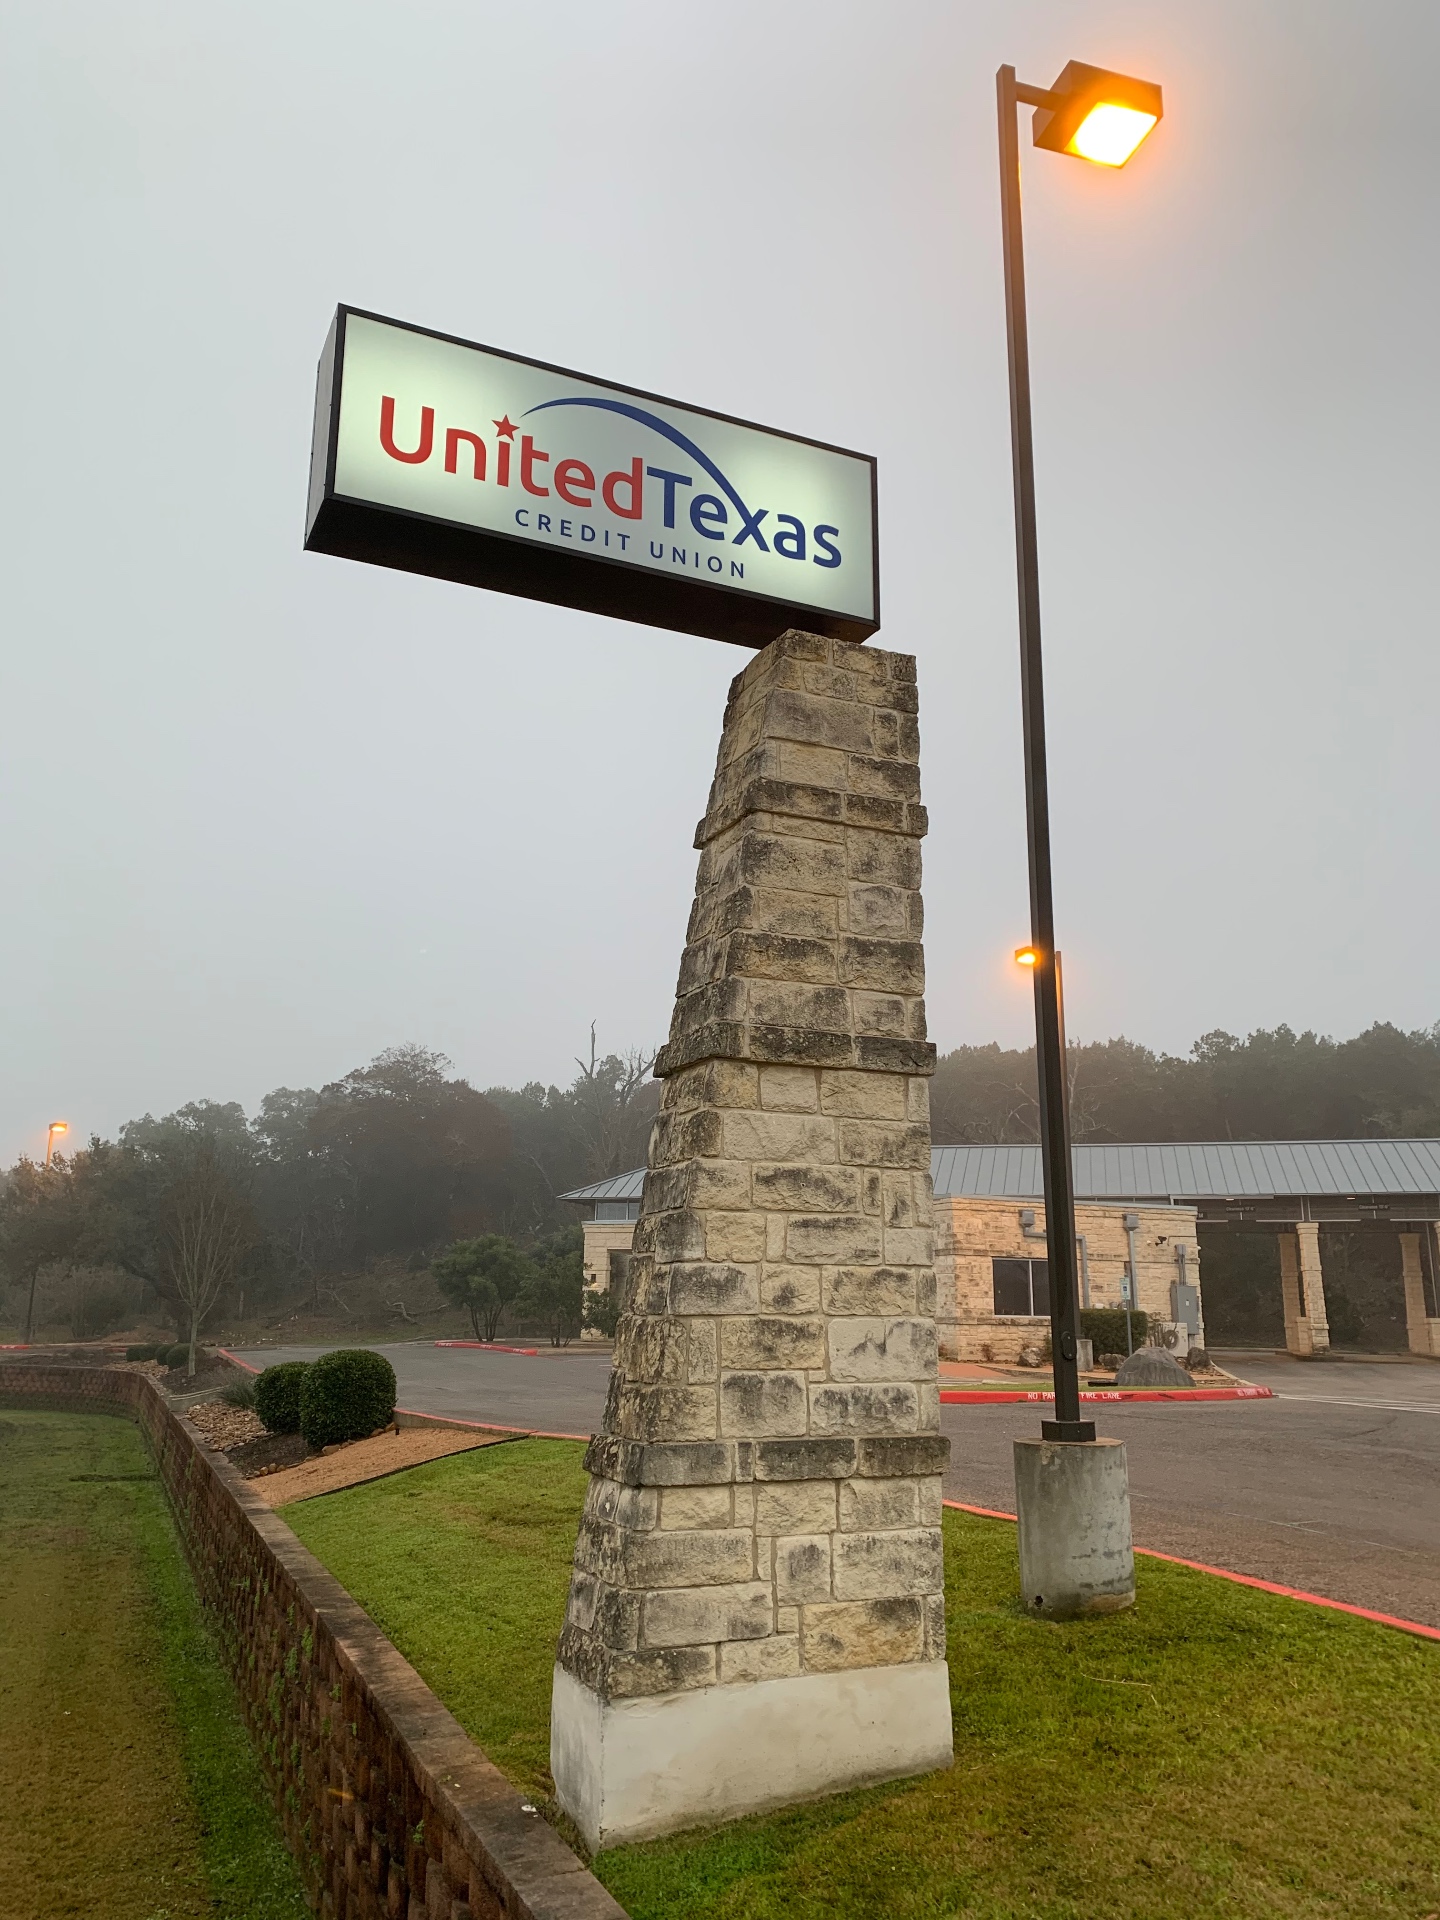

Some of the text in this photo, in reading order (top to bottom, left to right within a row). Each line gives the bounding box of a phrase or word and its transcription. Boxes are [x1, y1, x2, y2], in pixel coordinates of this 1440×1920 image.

[515, 508, 745, 579] CREDIT UNION
[1027, 1391, 1038, 1400] NO
[1081, 1391, 1098, 1400] FIRE
[1101, 1391, 1122, 1400] LANE
